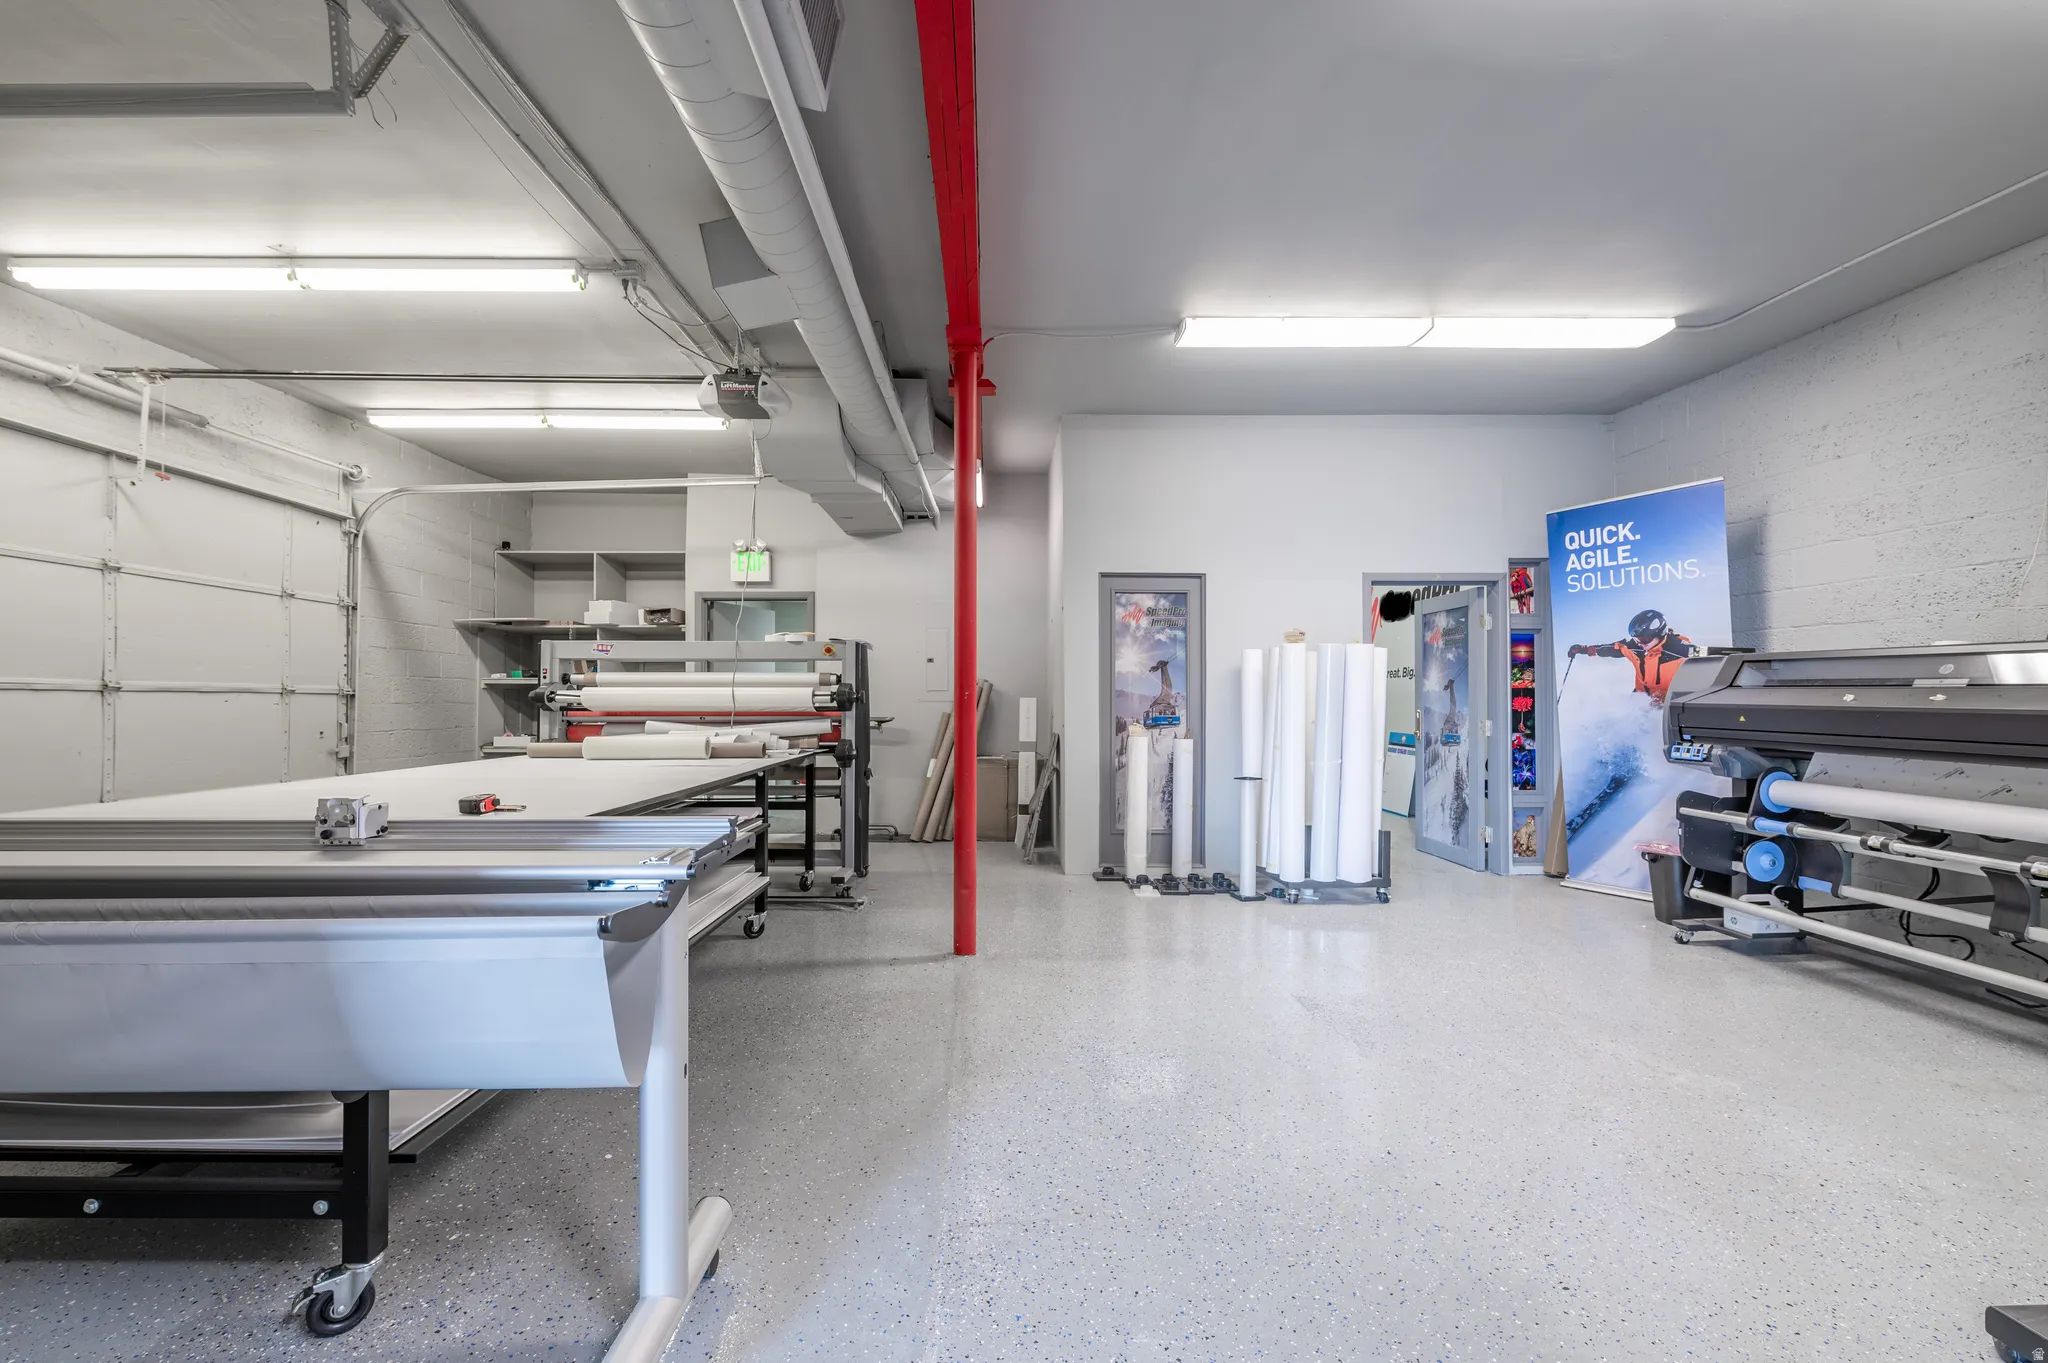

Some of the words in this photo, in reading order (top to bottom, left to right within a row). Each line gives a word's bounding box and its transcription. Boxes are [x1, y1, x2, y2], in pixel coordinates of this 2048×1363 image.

[1564, 521, 1641, 550] QUICK.
[737, 553, 763, 572] EXIT
[1565, 545, 1639, 572] AGILE.
[1567, 559, 1706, 593] SOLUTIONS.
[1386, 668, 1401, 679] reat.
[1402, 666, 1416, 680] Big.
